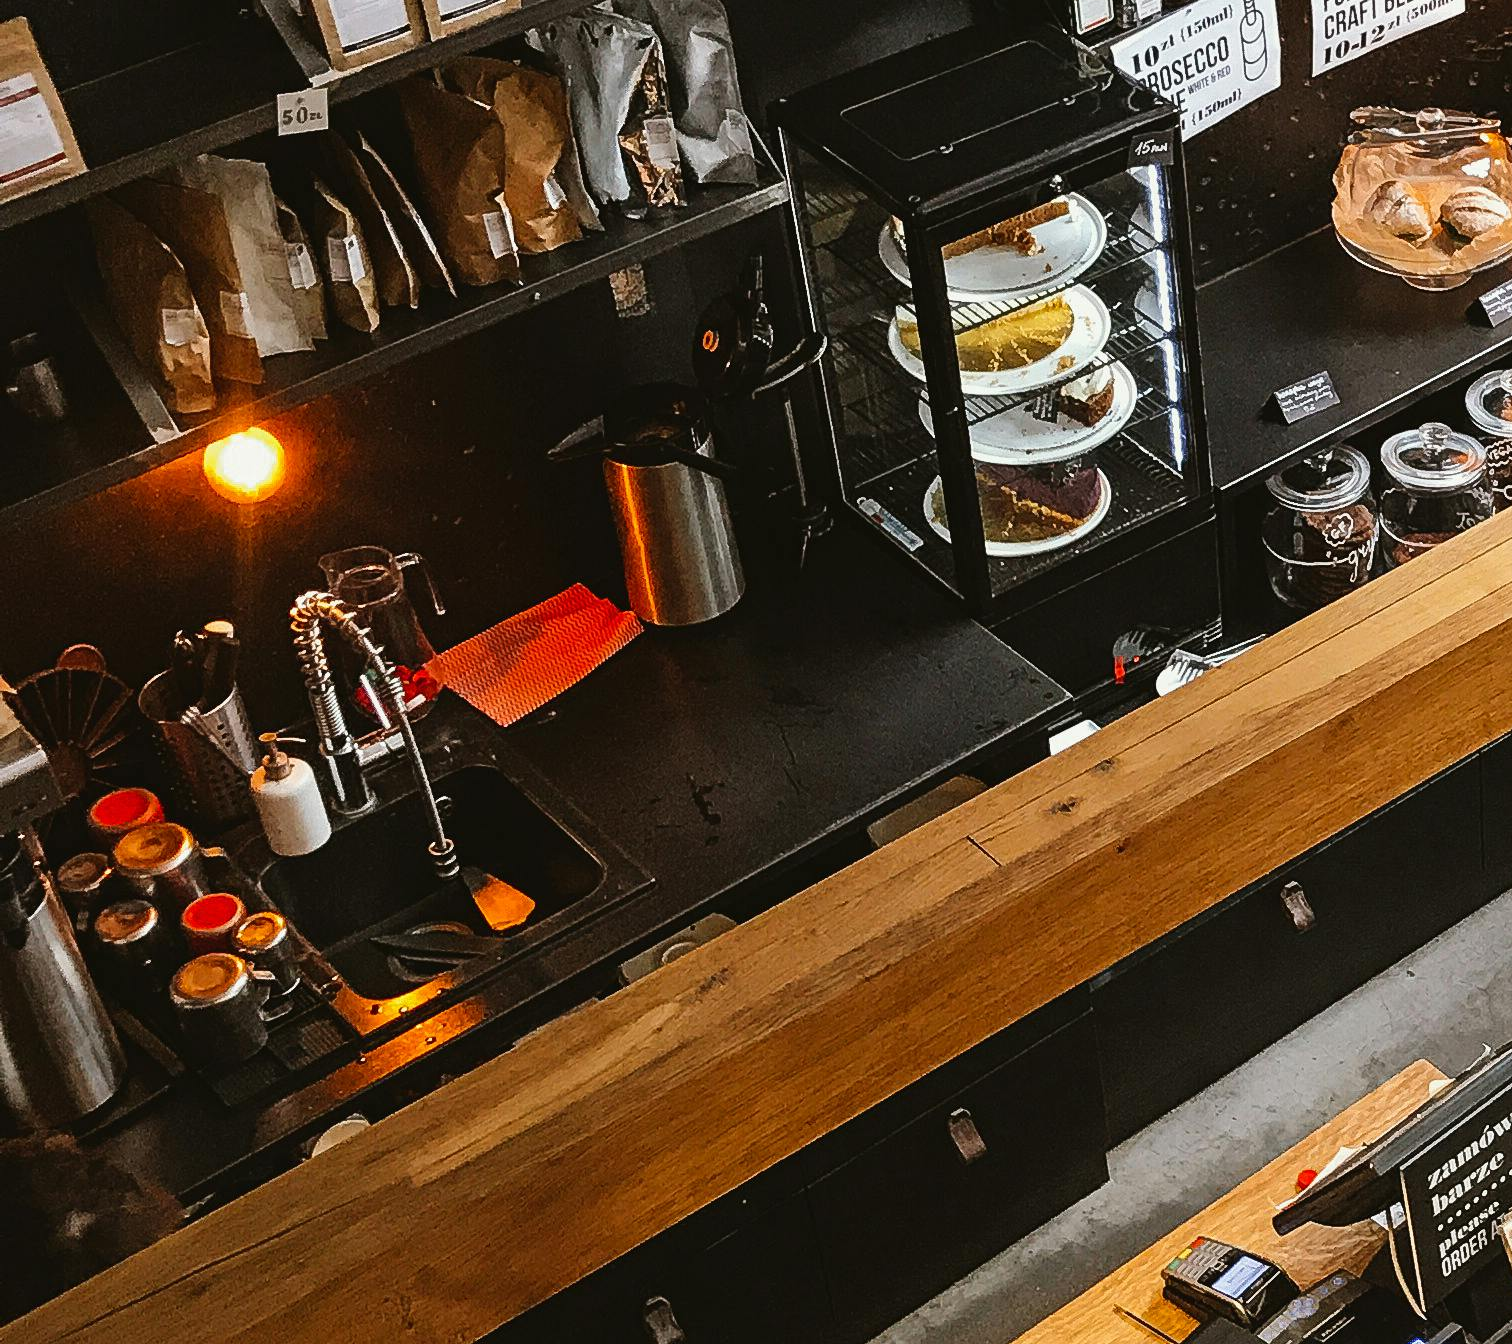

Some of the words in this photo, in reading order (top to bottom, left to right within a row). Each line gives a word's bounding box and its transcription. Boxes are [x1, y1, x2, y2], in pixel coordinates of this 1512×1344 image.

[1218, 66, 1231, 80] RED
[1431, 1152, 1504, 1216] barze
[1439, 1201, 1500, 1259] please
[1441, 1228, 1487, 1277] ORDER
